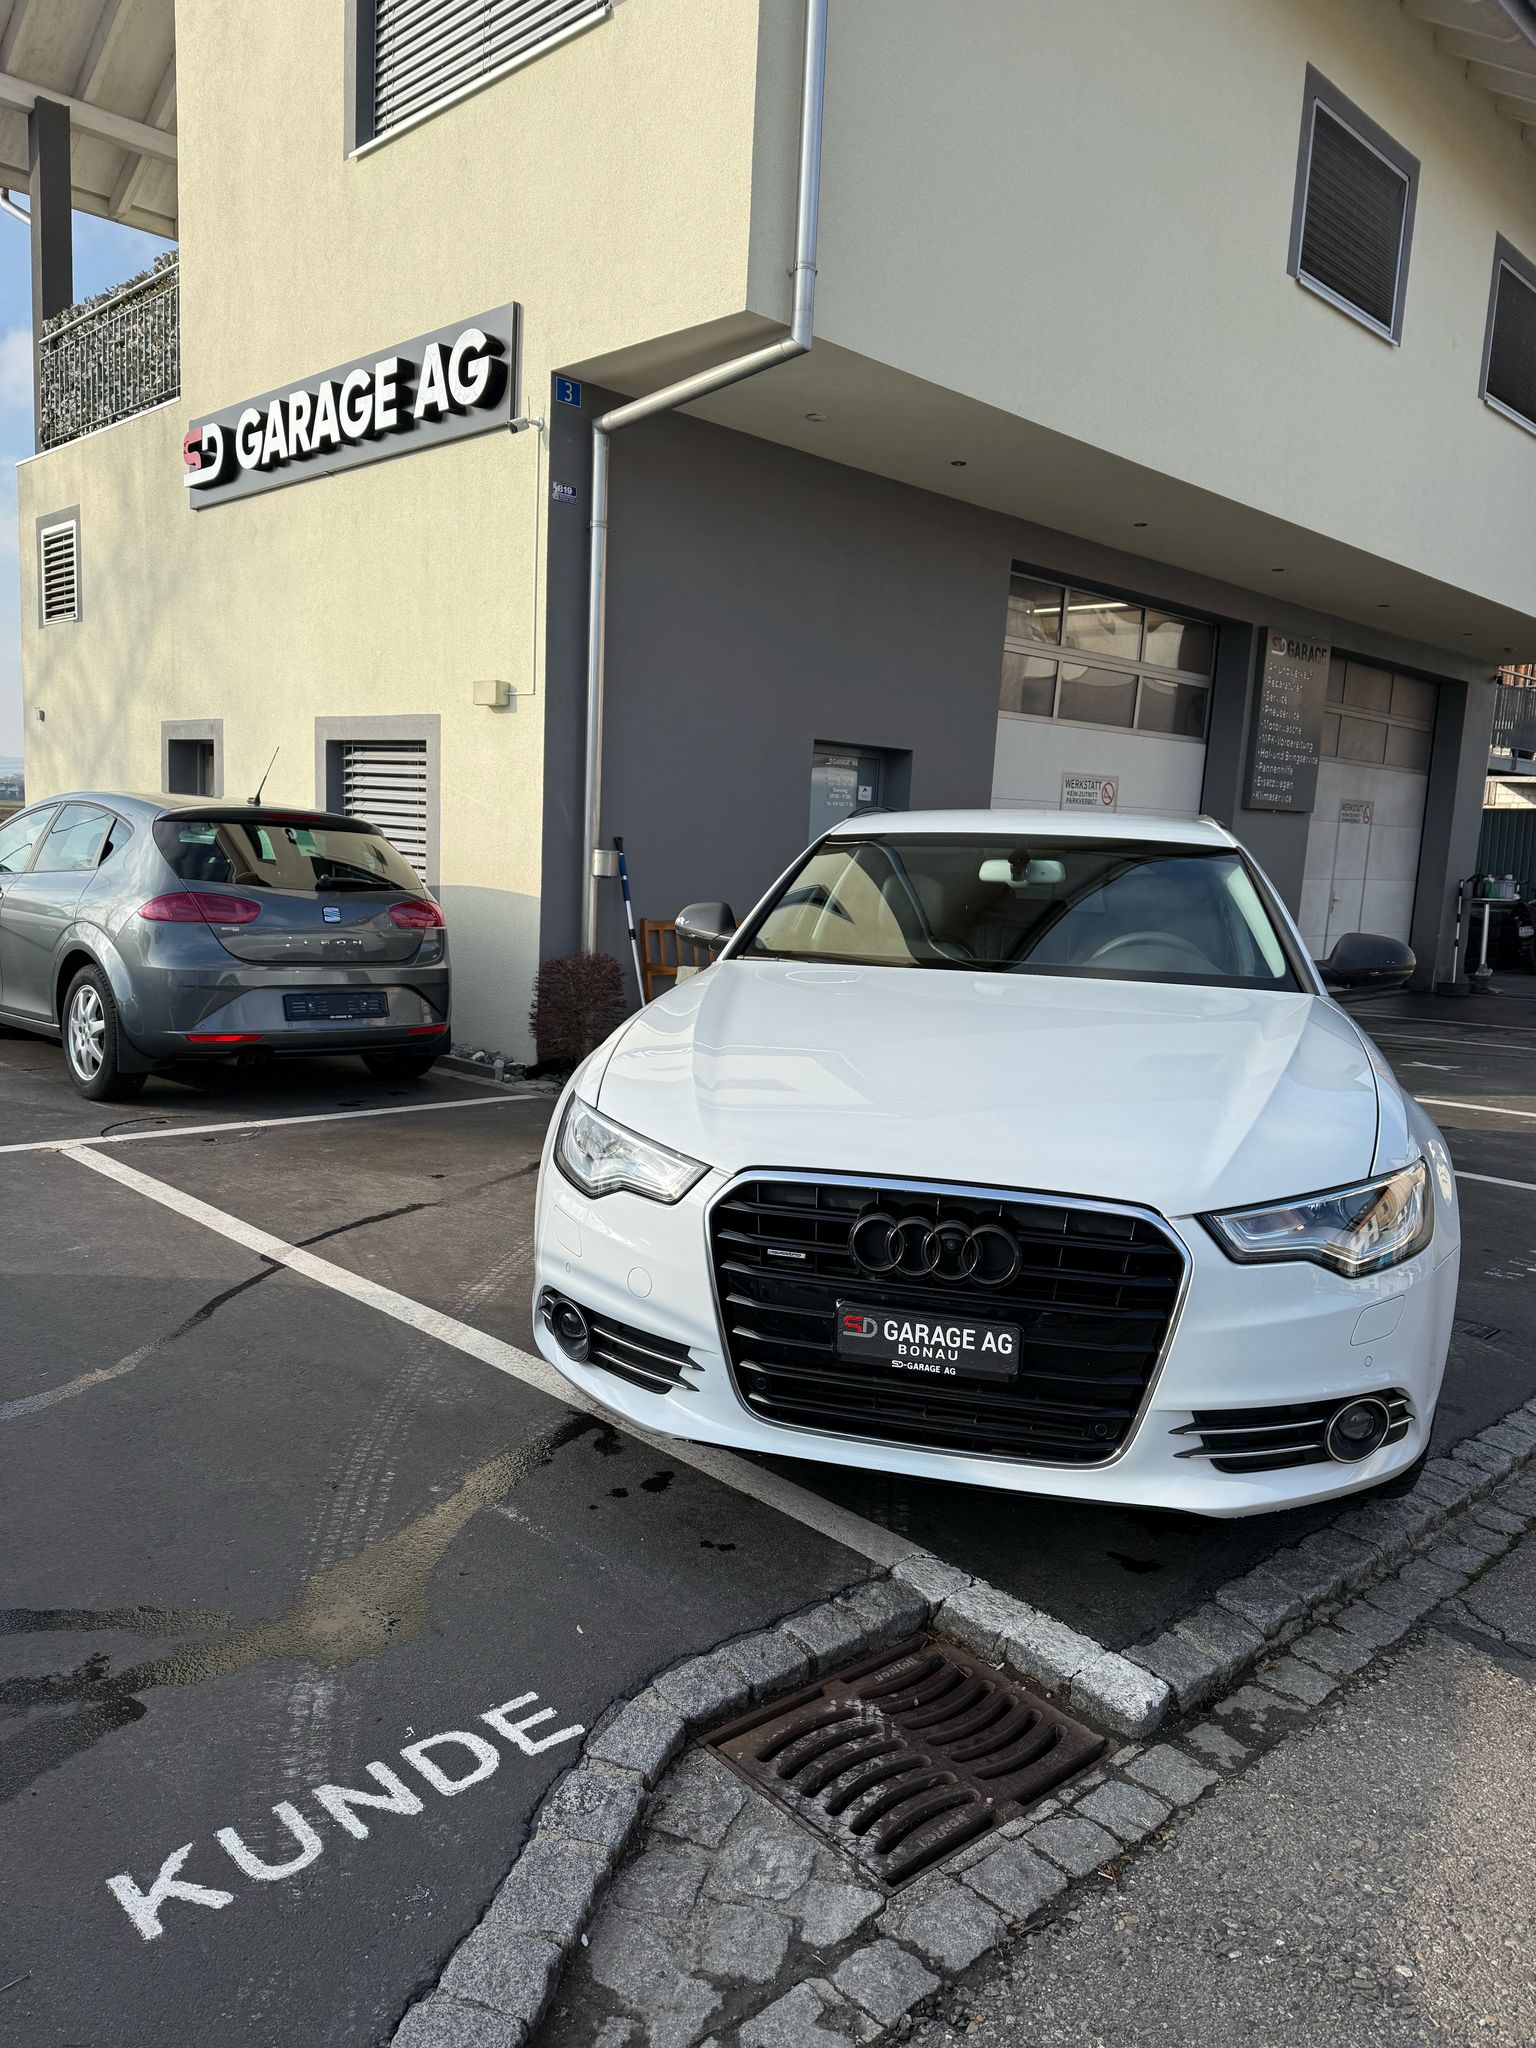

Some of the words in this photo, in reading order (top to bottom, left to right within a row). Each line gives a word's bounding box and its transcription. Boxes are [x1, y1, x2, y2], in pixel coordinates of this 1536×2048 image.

[564, 381, 573, 402] 3
[184, 422, 223, 487] SD
[235, 357, 399, 470] GARAGE
[413, 327, 496, 420] AG
[1287, 639, 1328, 664] GARAGE
[1266, 690, 1288, 704] Service
[1264, 704, 1300, 720] Pneuservice
[1258, 761, 1294, 776] Pannenhilfe
[1065, 779, 1102, 791] WERKSTATT
[1254, 789, 1292, 803] Klimaservice
[842, 1315, 878, 1338] SD
[883, 1320, 976, 1350] GARAGE
[981, 1331, 1013, 1355] AG
[898, 1344, 958, 1361] BONAU
[943, 1367, 956, 1375] AG
[106, 1691, 586, 1941] KUNDE
